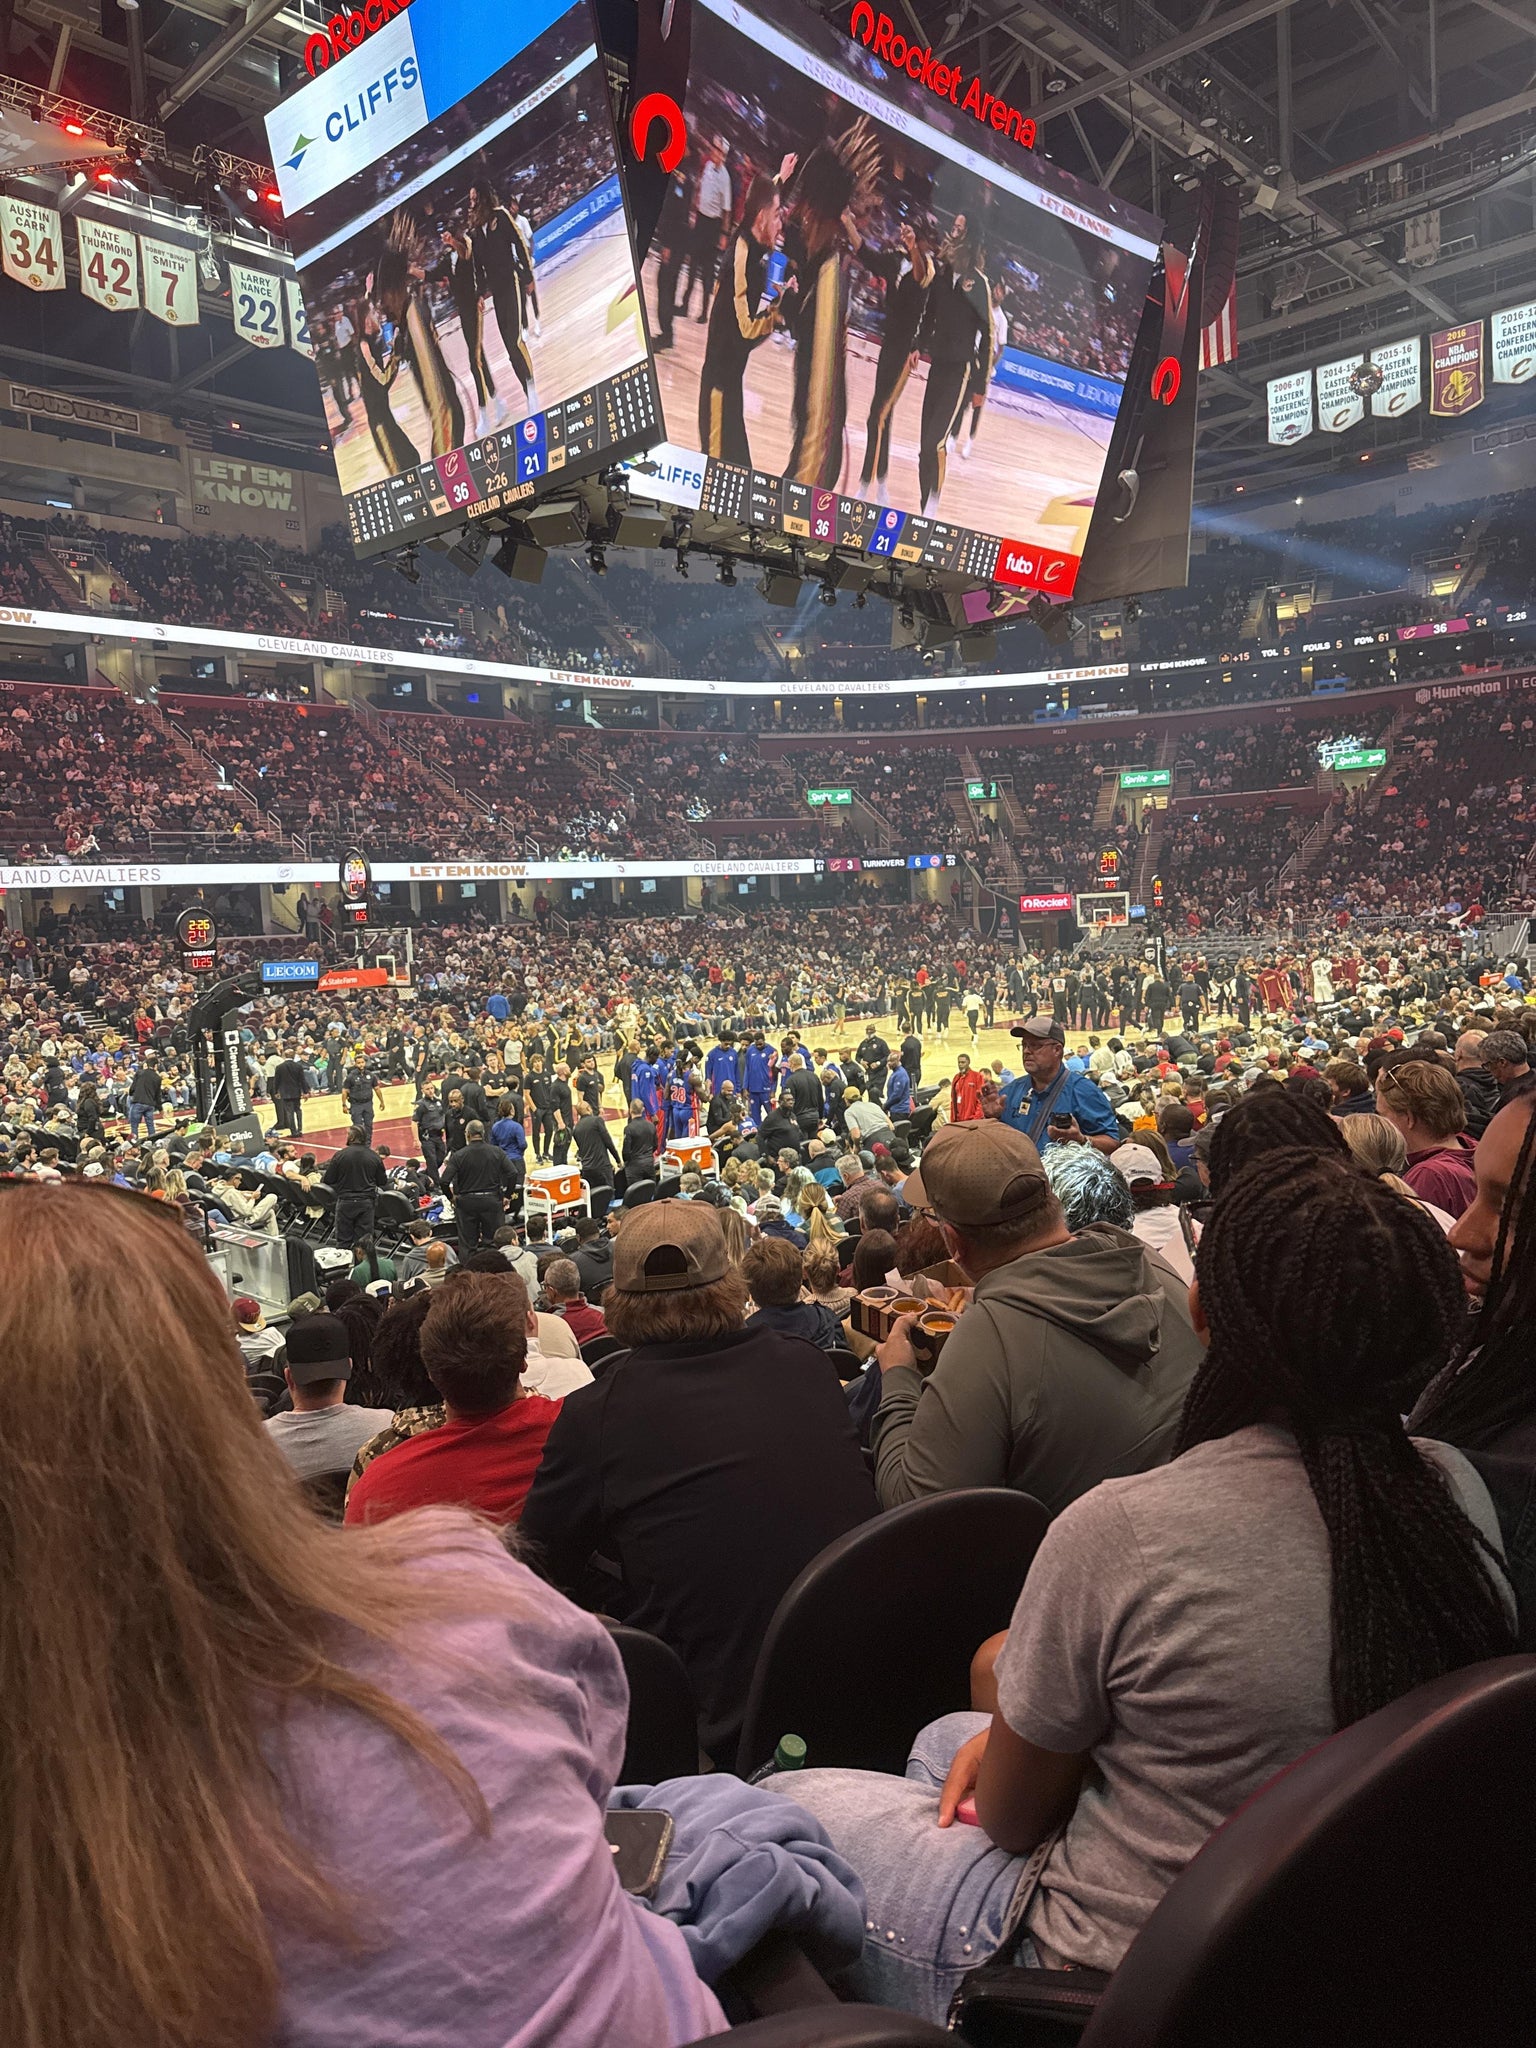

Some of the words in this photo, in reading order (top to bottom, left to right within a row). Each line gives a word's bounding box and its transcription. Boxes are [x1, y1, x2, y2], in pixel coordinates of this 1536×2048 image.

[872, 12, 962, 105] Rocket
[961, 77, 1036, 149] Arena
[325, 56, 418, 142] CLIFFS
[10, 204, 50, 223] AUSTIN
[15, 217, 46, 233] CARR
[94, 228, 120, 244] NATE
[9, 229, 58, 276] 34
[81, 235, 133, 257] THURMOND
[152, 255, 185, 272] SMITH
[88, 252, 132, 296] 42
[240, 271, 271, 287] LARRY
[161, 270, 178, 307] 7
[240, 282, 272, 297] NANCE
[239, 294, 278, 335] 22
[1447, 329, 1467, 342] 2016
[1502, 320, 1536, 337] EASTERN
[1496, 332, 1536, 350] CONFEREN
[1378, 344, 1412, 362] 2015-16
[1448, 343, 1465, 356] NBA
[1498, 342, 1536, 360] CHAMPION
[1435, 349, 1479, 369] CHAMPIONS
[1323, 362, 1356, 378] 2014-15
[1383, 365, 1418, 382] NFERENCE
[615, 387, 620, 396] 9
[625, 382, 629, 391] 1
[634, 377, 640, 387] 0
[643, 372, 648, 382] 0
[1273, 377, 1305, 392] 2006-07
[1325, 376, 1350, 389] EASTER
[583, 394, 592, 406] 33
[1275, 389, 1304, 404] EASTERN
[1320, 386, 1354, 400] CONFEREN
[1270, 398, 1310, 415] CONFERENCE
[1321, 395, 1359, 410] CHAMPIONS
[585, 415, 594, 427] 66
[1272, 408, 1308, 424] CHAMPIONS
[553, 426, 560, 439] 5
[622, 428, 627, 438] 0
[632, 424, 636, 433] 1
[641, 419, 646, 428] 0
[650, 415, 655, 424] 1
[501, 434, 512, 448] 24
[587, 438, 593, 449] 6
[469, 447, 482, 462] 1Q
[487, 454, 498, 464] +15
[524, 453, 540, 476] 21
[193, 458, 246, 481] LET
[251, 466, 292, 489] EM
[406, 473, 415, 484] 61
[429, 479, 436, 491] 5
[485, 472, 508, 493] 2:26
[769, 480, 778, 489] 61
[194, 480, 298, 512] KNOW.
[414, 489, 422, 500] 71
[453, 482, 469, 503] 36
[467, 494, 500, 518] CLEVELAND
[503, 481, 535, 505] CAVALIERS
[768, 497, 776, 507] 71
[793, 500, 799, 511] 5
[840, 502, 852, 515] 1Q
[422, 507, 427, 516] 5
[867, 510, 876, 520] 24
[770, 516, 775, 524] 5
[815, 519, 830, 537] 36
[950, 529, 958, 538] 33
[842, 532, 863, 548] 2:26
[876, 535, 890, 552] 21
[912, 531, 919, 542] 5
[1005, 552, 1033, 575] fubo
[0, 610, 37, 624] OW.
[1475, 618, 1487, 627] 24
[1506, 611, 1527, 622] 2:26
[1433, 623, 1447, 634] 36
[1378, 633, 1390, 643] 61
[258, 638, 328, 655] CLEVELAND
[331, 645, 394, 662] CAVALIERS
[1261, 650, 1279, 658] TOL
[1283, 647, 1290, 656] 5
[1302, 642, 1331, 652] FOULS
[1335, 640, 1343, 649] 5
[1232, 652, 1250, 662] +15
[1141, 663, 1159, 672] LET
[550, 672, 571, 682] LET
[574, 675, 591, 684] EM
[593, 676, 634, 688] KNOW.
[1047, 671, 1073, 681] LET
[1075, 669, 1095, 678] EM
[780, 684, 835, 692] CLEVELAND
[838, 683, 890, 692] CAVALIERS
[1432, 682, 1501, 699] Huntington
[1337, 755, 1363, 766] Sprite
[1124, 774, 1148, 784] Sprite
[693, 863, 745, 873] CLEVELAND
[748, 861, 800, 872] CAVALIERS
[847, 861, 853, 870] 3
[862, 859, 905, 868] TURNOVERS
[915, 858, 921, 866] 6
[1100, 860, 1117, 873] 24
[59, 868, 161, 883] CAVALIERS
[409, 866, 443, 877] LET
[446, 865, 471, 877] EM
[474, 865, 529, 876] KNOW.
[1033, 897, 1069, 908] Rocket
[189, 920, 210, 930] 2:26
[188, 930, 207, 943] 24
[266, 965, 315, 977] LECOM
[229, 1046, 242, 1088] Cleveland
[234, 1087, 246, 1112] Clinic
[670, 1085, 687, 1104] 28
[229, 1130, 253, 1142] Clinic
[691, 1150, 702, 1163] G
[559, 1179, 571, 1195] G
